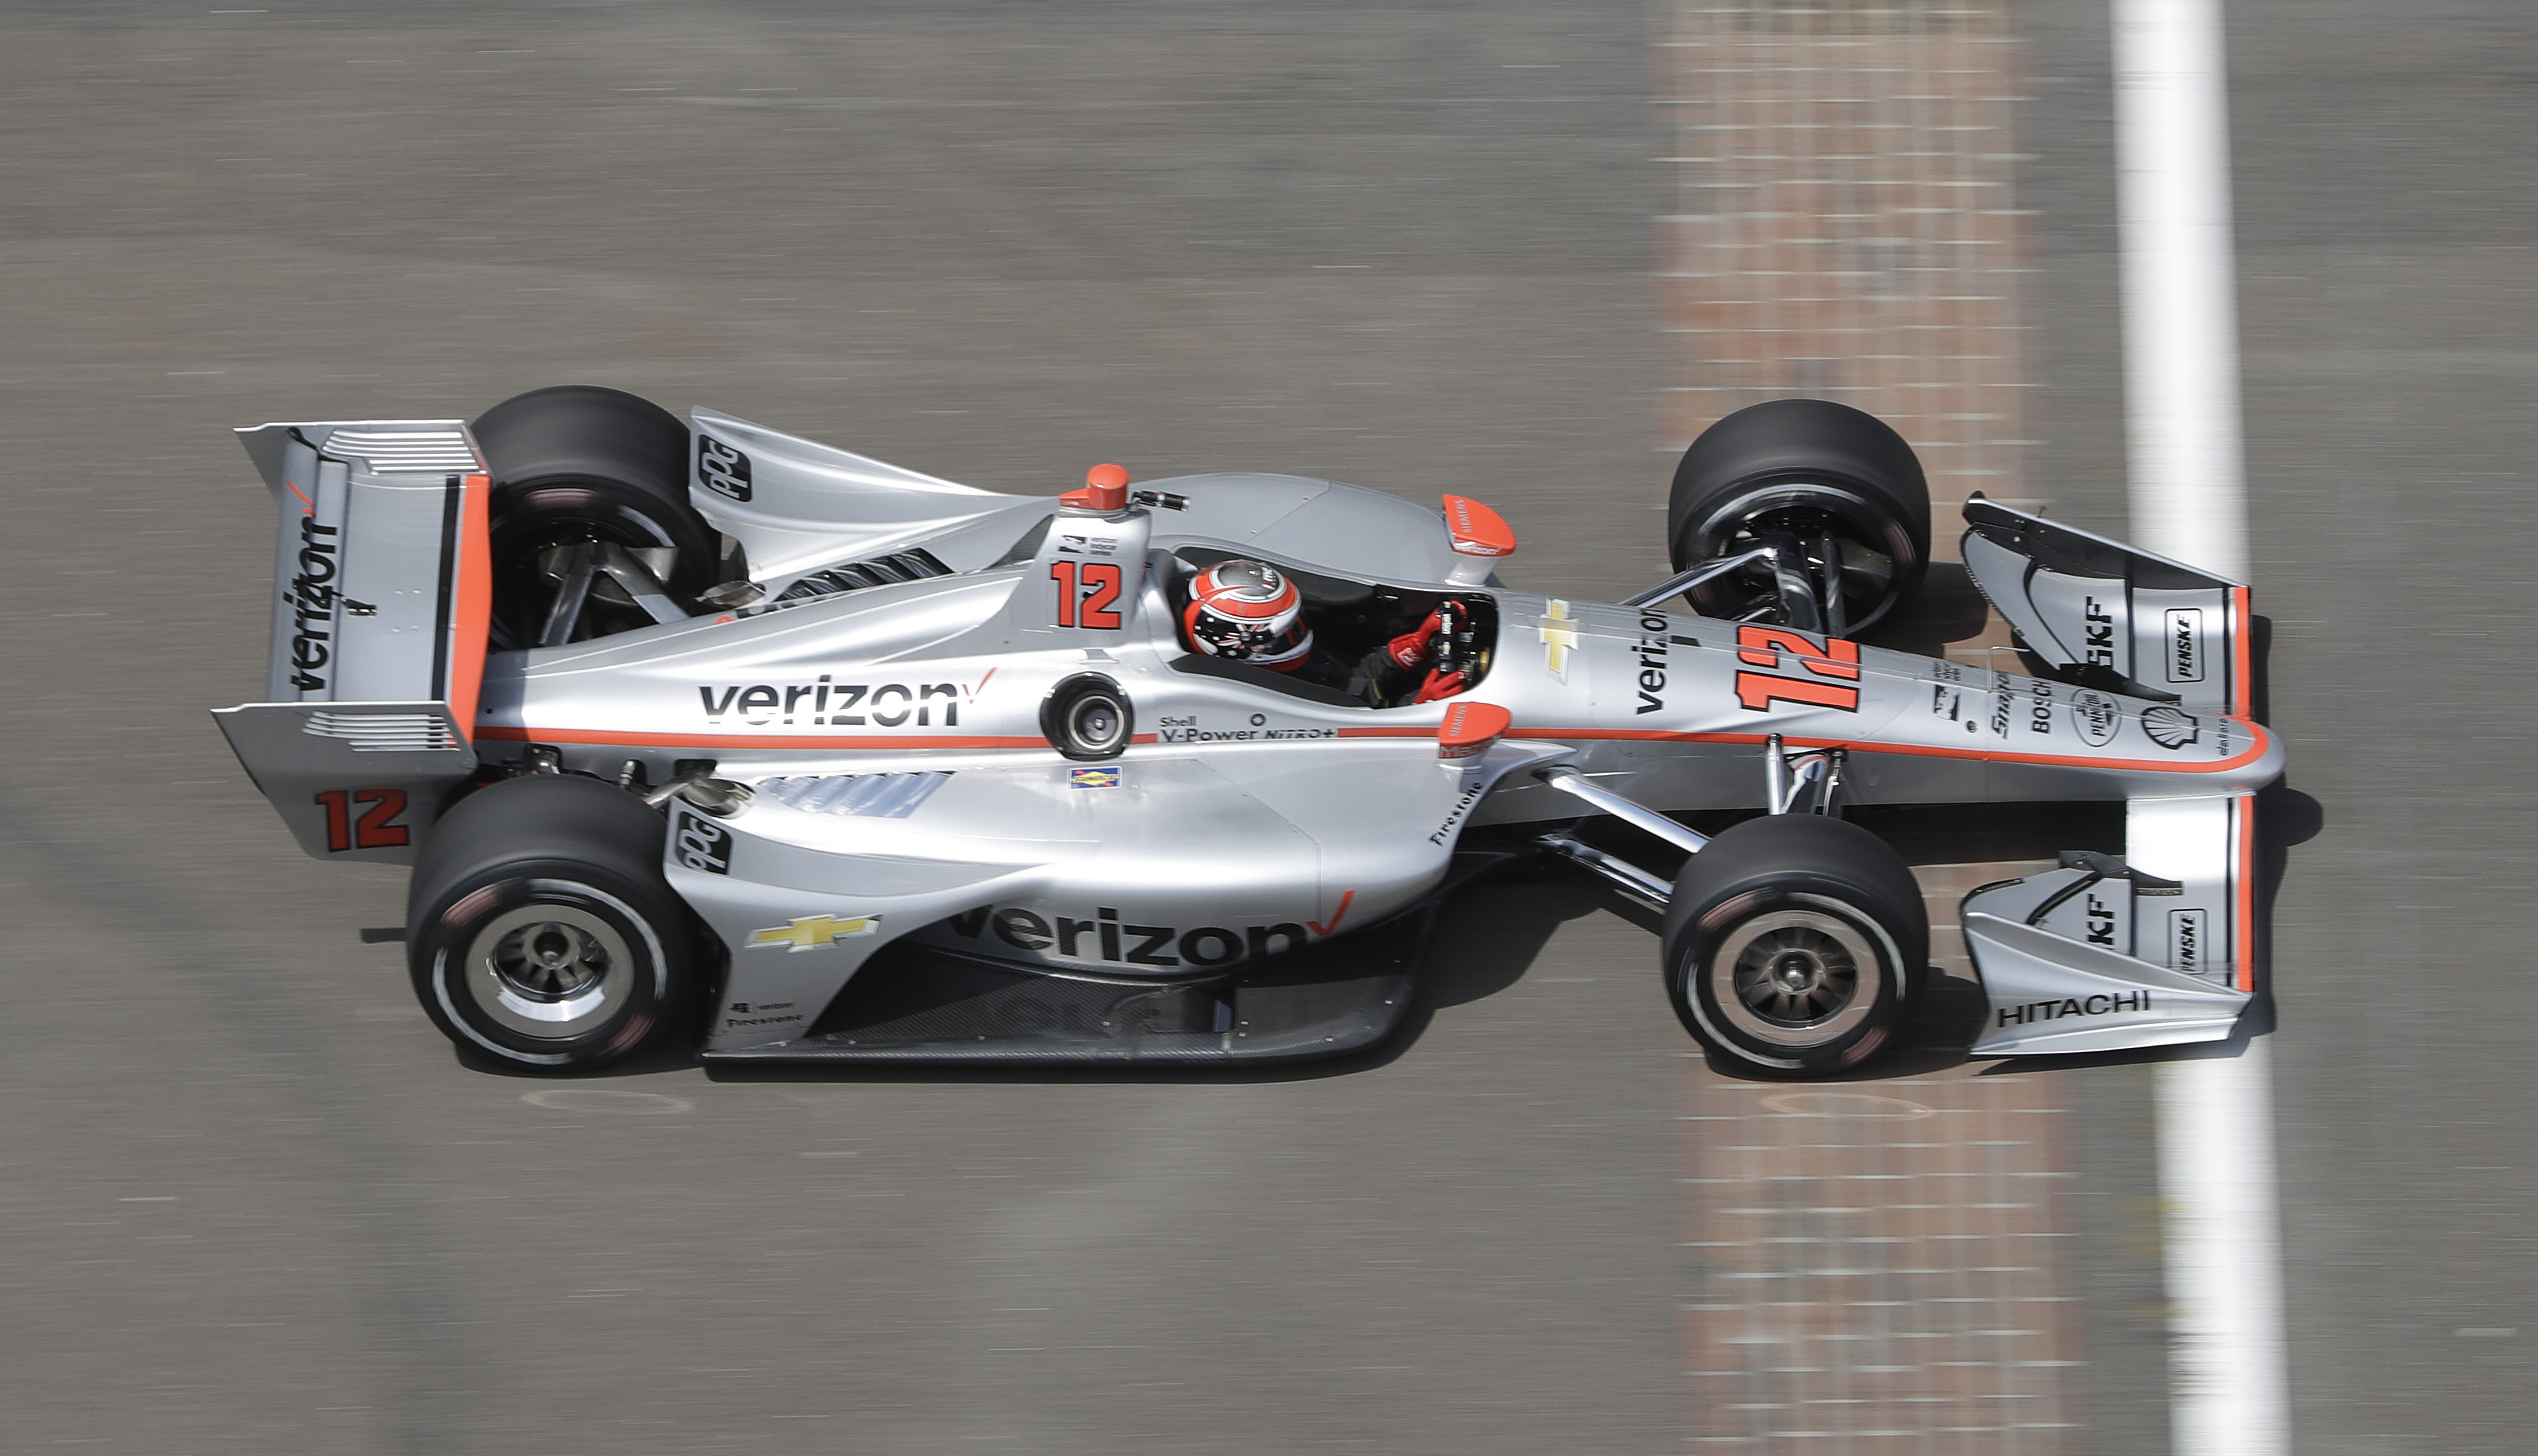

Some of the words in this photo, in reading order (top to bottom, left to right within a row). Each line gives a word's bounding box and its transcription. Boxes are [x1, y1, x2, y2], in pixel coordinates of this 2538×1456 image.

[701, 440, 748, 498] PPG
[1454, 499, 1472, 533] SIEMENS
[283, 517, 337, 691] verizon
[1051, 560, 1121, 630] 12
[2086, 596, 2112, 669] SKF
[2176, 614, 2193, 678] PENSKE
[1632, 609, 1668, 715] verizon
[1735, 625, 1862, 714] 12
[698, 674, 959, 727] verizon
[1160, 716, 1196, 727] Shell
[1449, 705, 1468, 737] SIEMENS
[2032, 680, 2051, 734] BOSCH
[1160, 728, 1259, 742] V-Power
[316, 788, 410, 852] 12
[1429, 782, 1483, 846] Firestone
[678, 817, 726, 871] PPG
[947, 906, 1308, 966] verizon
[2088, 894, 2115, 950] KF
[1998, 989, 2152, 1028] HITACHI
